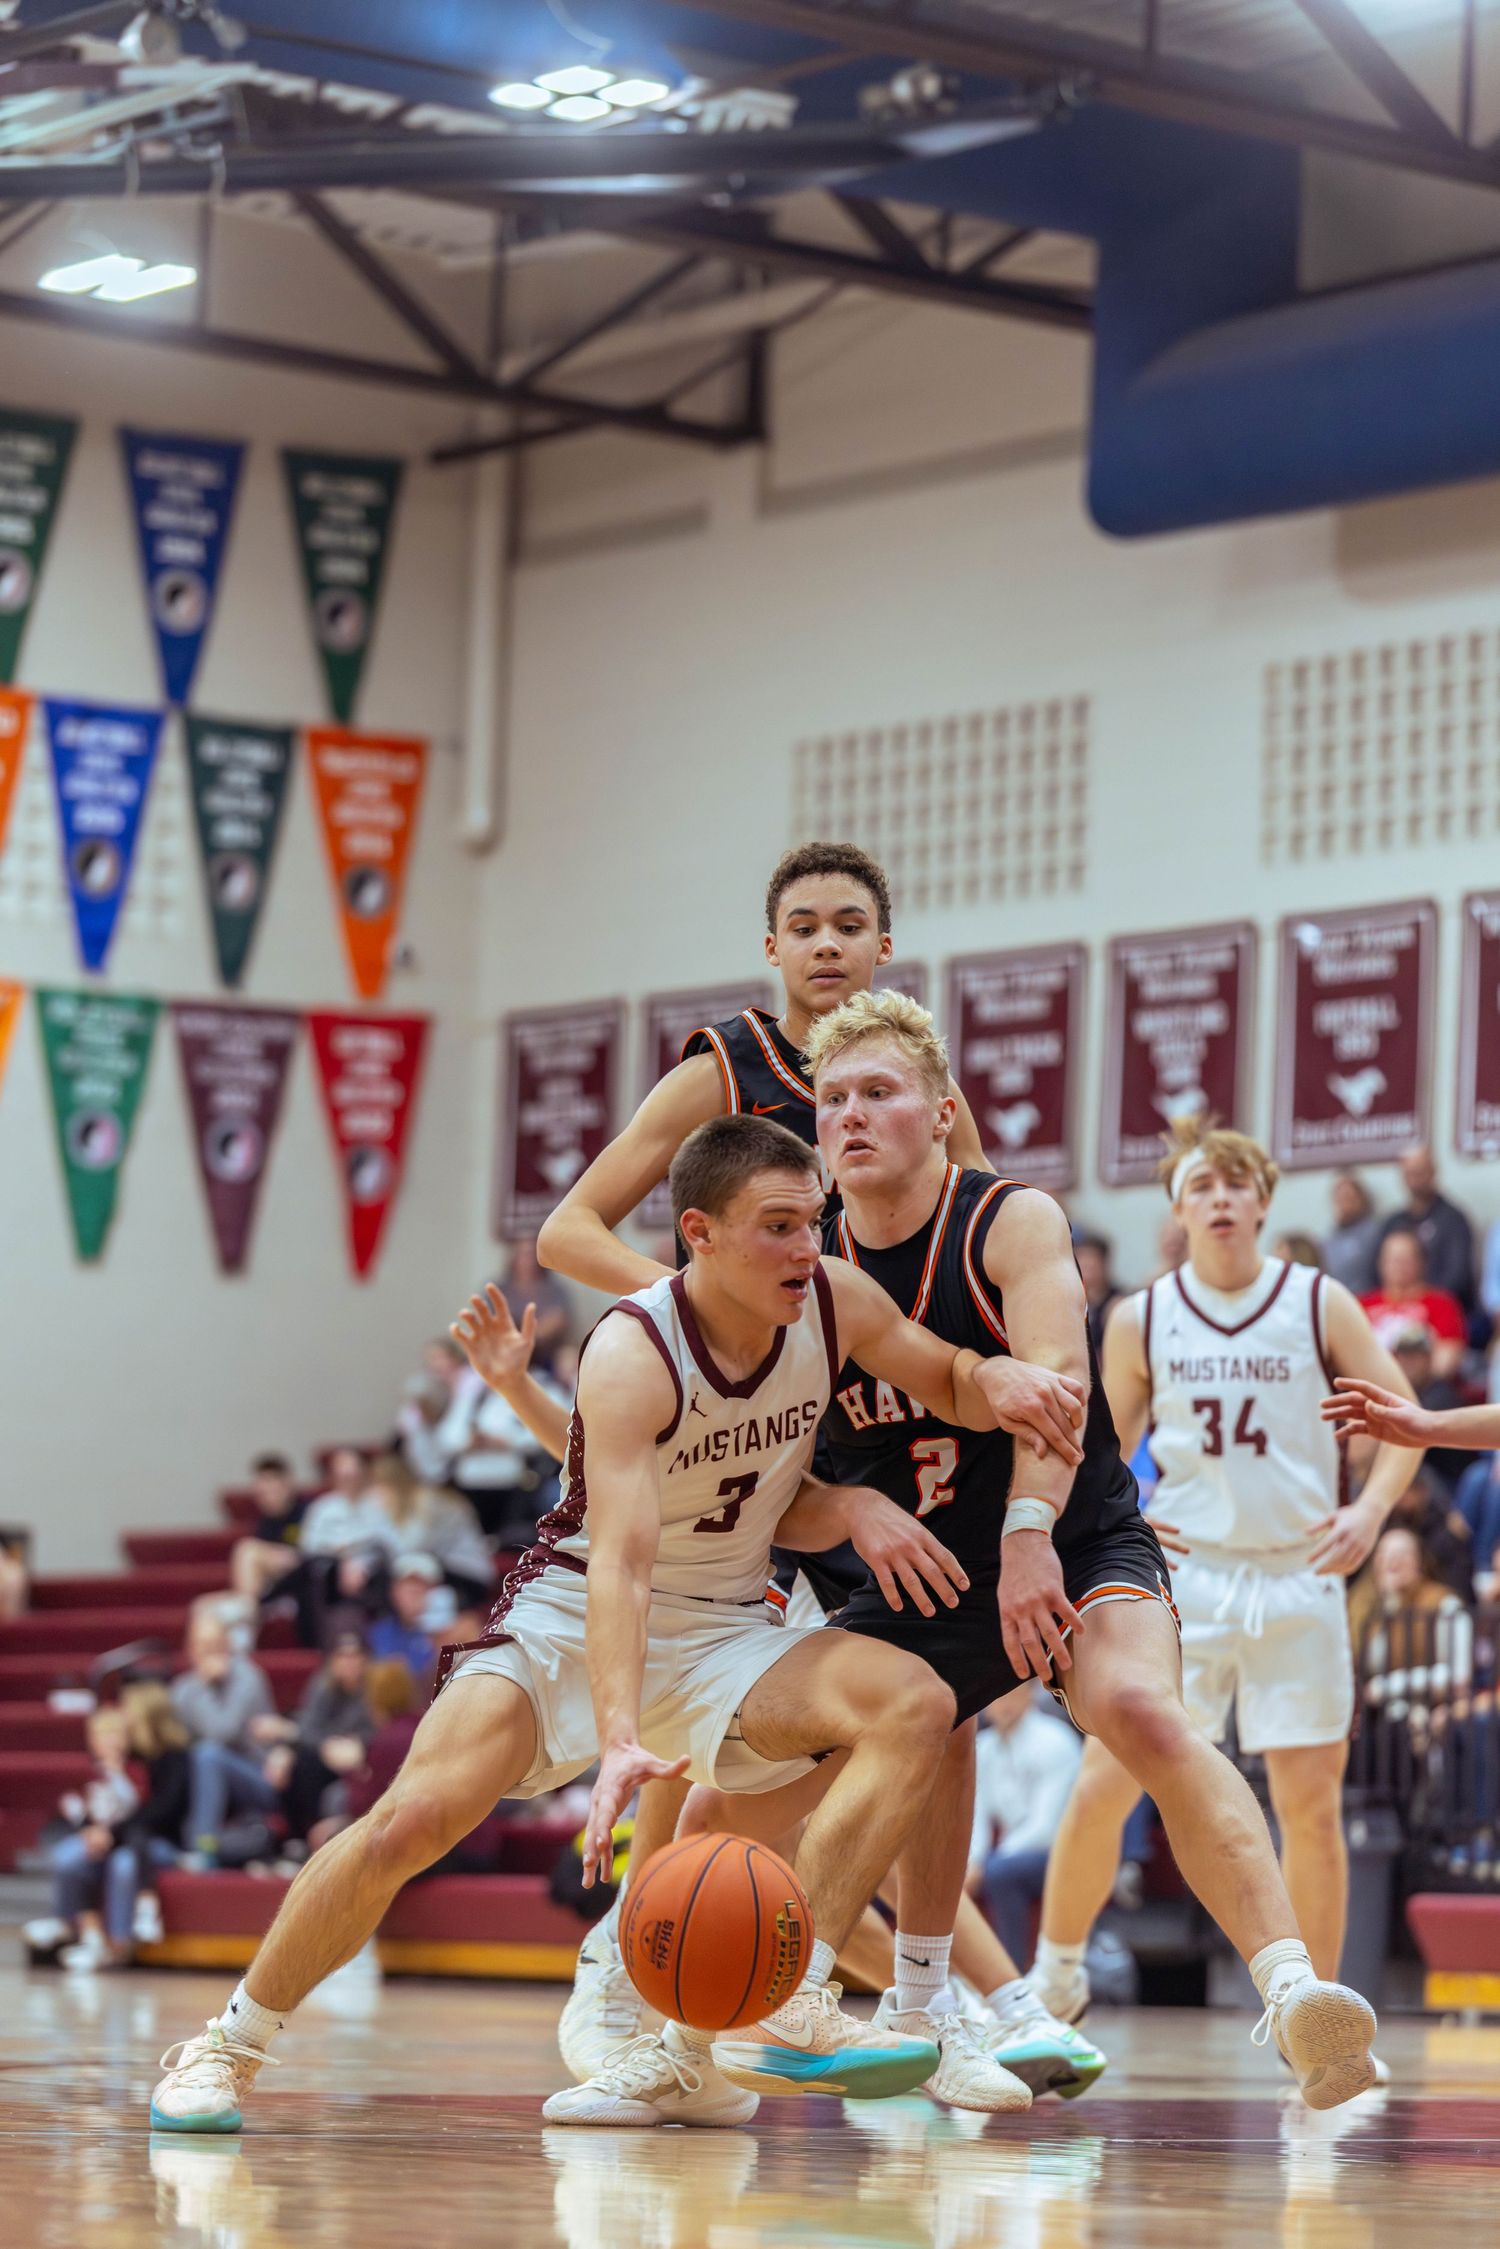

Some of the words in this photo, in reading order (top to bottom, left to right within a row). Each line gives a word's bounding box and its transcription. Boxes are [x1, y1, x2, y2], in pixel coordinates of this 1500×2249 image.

[1169, 1356, 1290, 1382] MUSTANGS
[668, 1400, 817, 1474] MUSTANGS
[1193, 1397, 1267, 1456] 34
[693, 1471, 759, 1532] 3
[908, 1436, 959, 1518] 2
